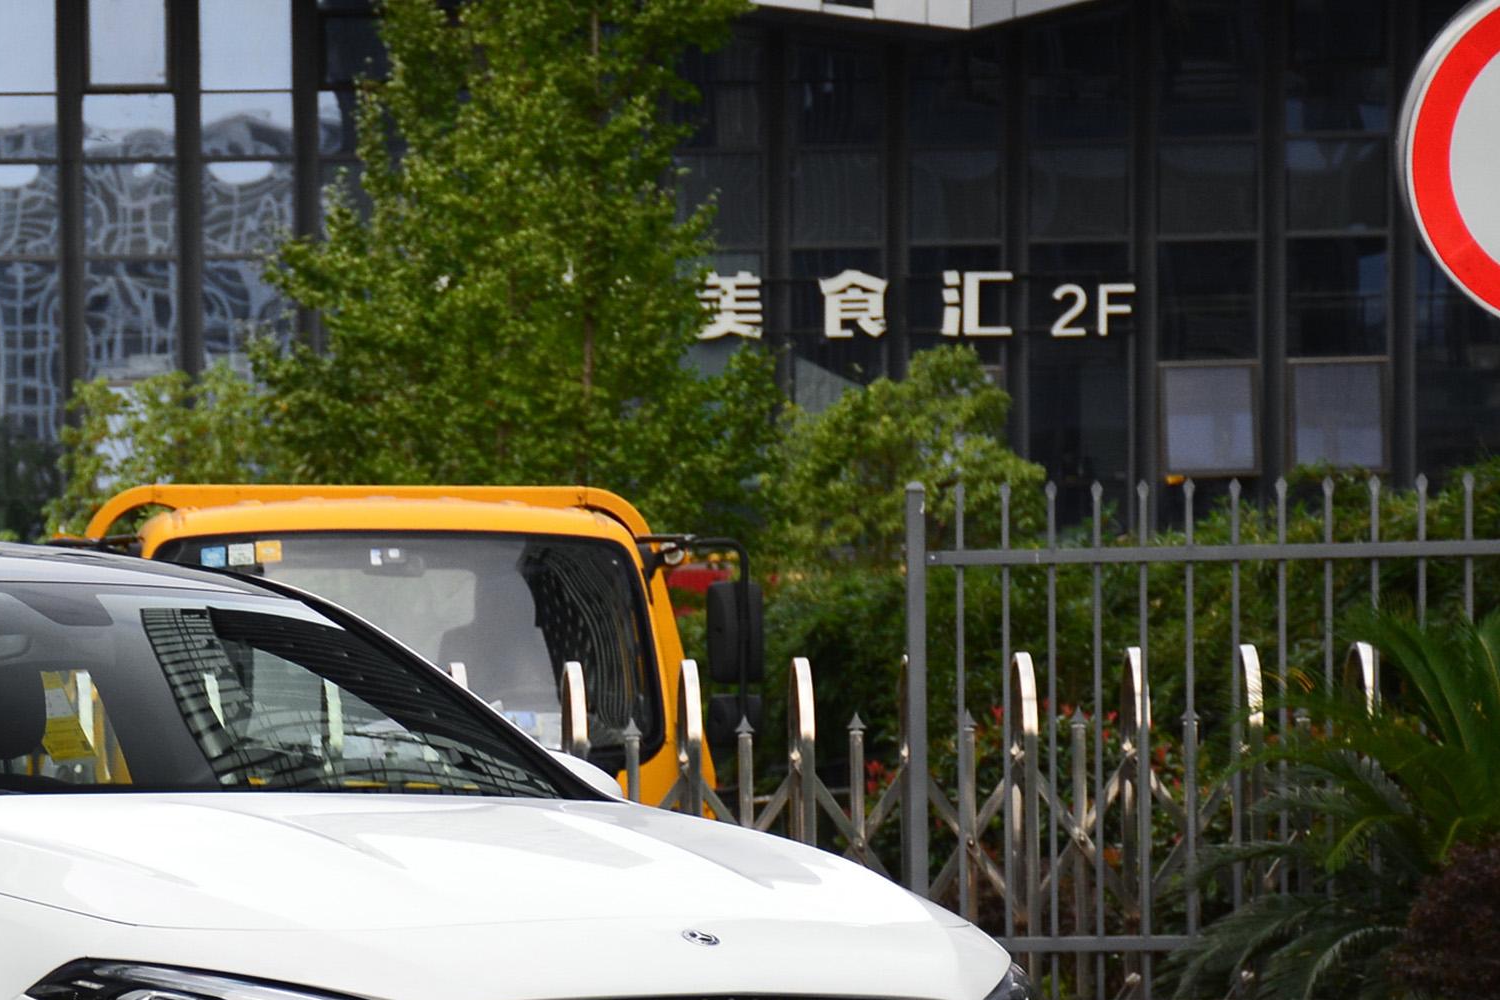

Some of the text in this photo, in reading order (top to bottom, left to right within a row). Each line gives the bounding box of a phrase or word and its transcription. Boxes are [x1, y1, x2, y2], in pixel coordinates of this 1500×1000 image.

[696, 269, 1136, 339] 美食汇 2F
